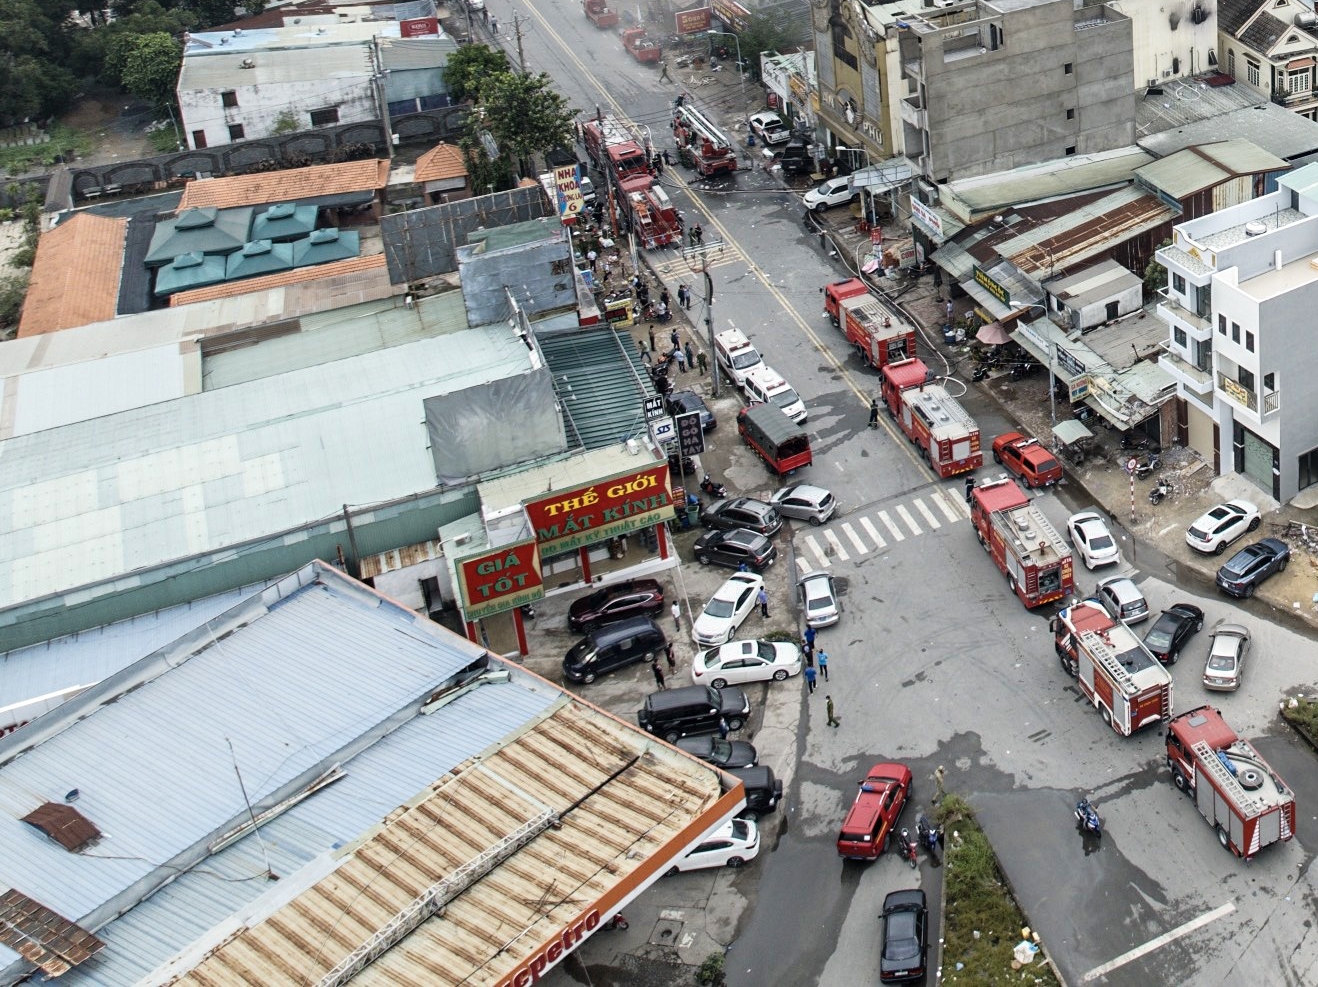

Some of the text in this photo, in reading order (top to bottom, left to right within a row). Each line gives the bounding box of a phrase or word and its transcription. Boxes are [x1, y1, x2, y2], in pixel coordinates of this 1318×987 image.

[557, 167, 577, 180] NHA
[558, 181, 580, 192] KHOA
[569, 202, 577, 211] 6
[544, 474, 658, 517] THẾ GIỚI
[538, 492, 668, 542] MẮT KÍNH
[477, 551, 521, 576] GIÁ
[477, 572, 529, 598] TỐT
